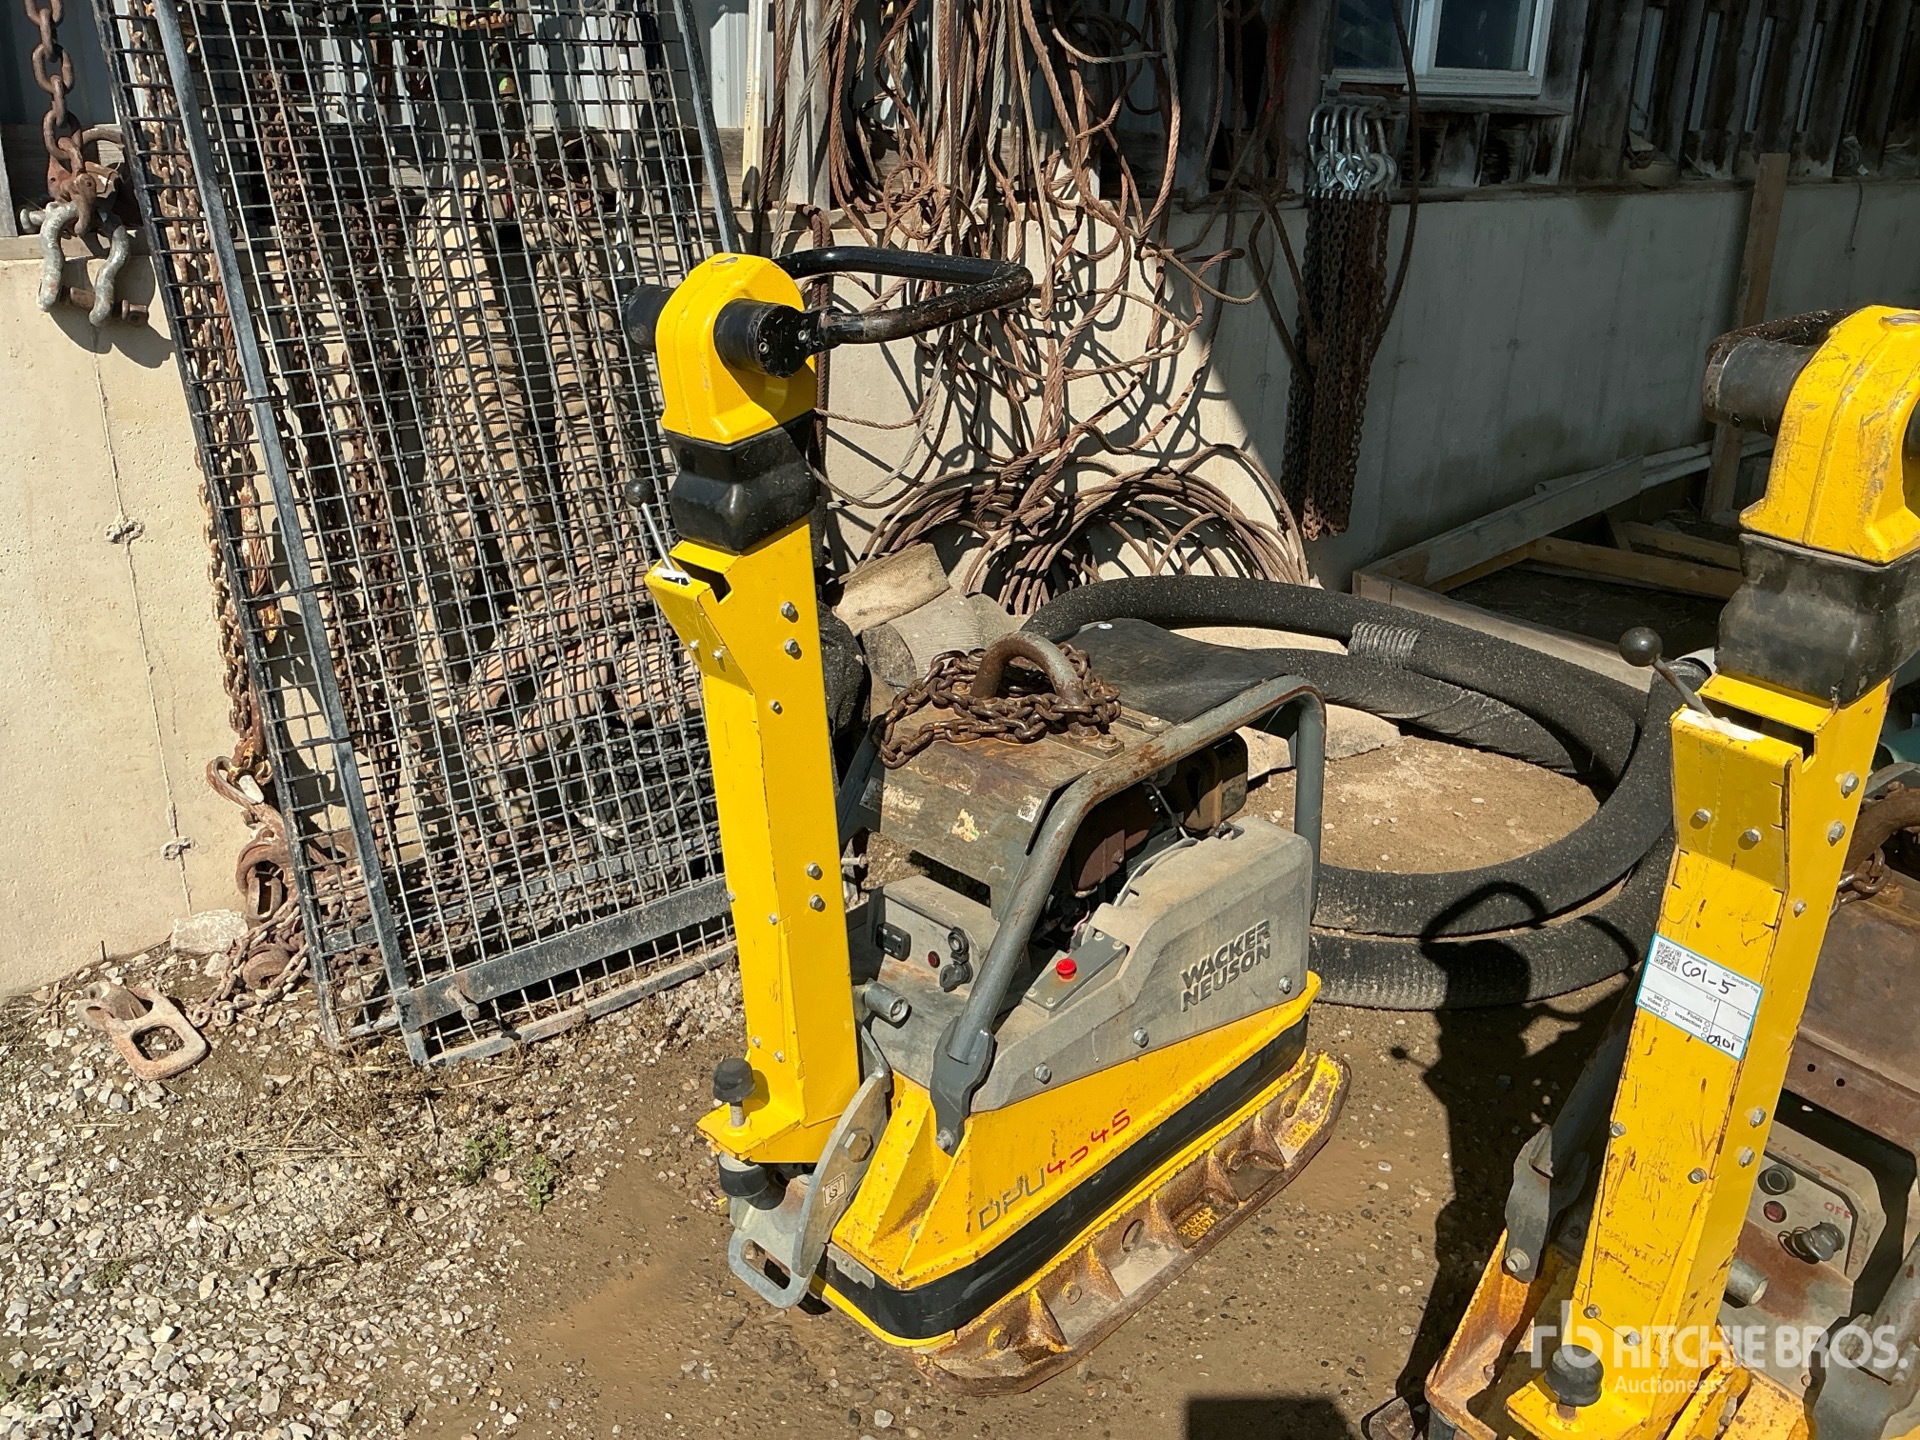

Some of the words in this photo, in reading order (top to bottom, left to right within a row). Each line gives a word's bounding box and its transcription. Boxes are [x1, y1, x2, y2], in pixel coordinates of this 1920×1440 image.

[1180, 918, 1271, 989] WACKER
[1180, 941, 1271, 1012] NEUSON
[1647, 996, 1662, 1007] Video
[1674, 1011, 1702, 1029] Inspection
